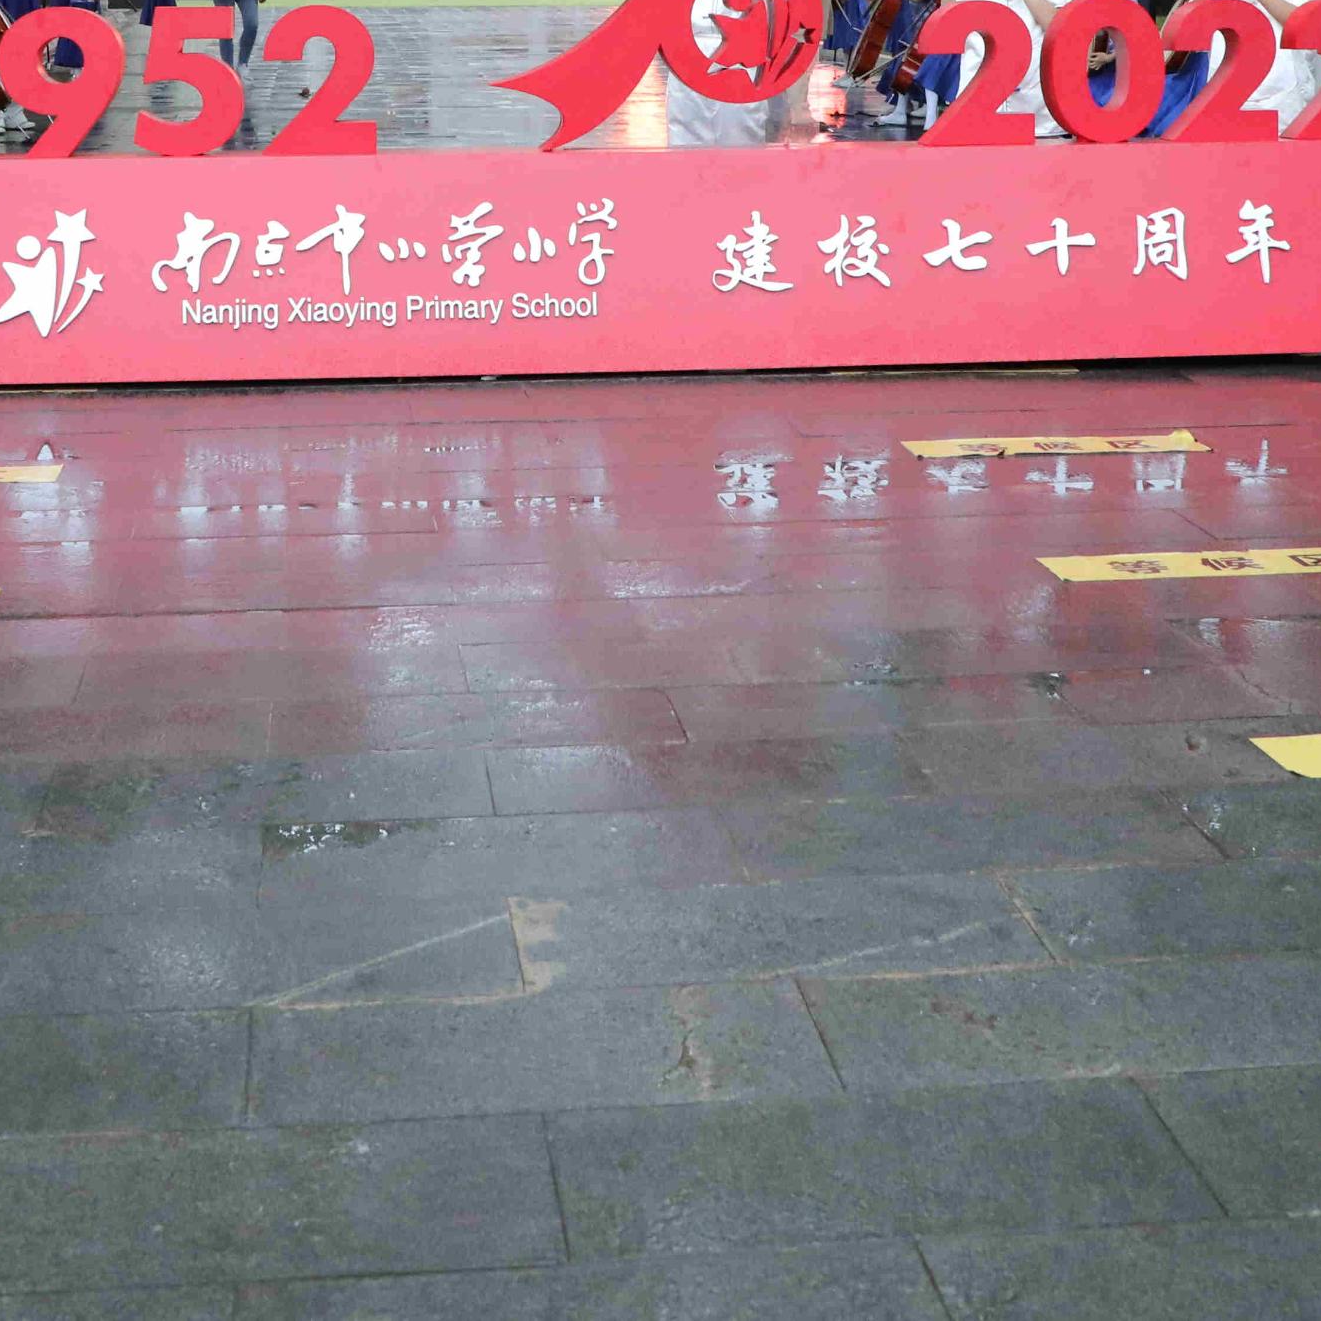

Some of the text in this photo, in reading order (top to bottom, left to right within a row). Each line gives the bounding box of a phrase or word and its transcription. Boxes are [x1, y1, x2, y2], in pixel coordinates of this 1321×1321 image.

[712, 198, 1291, 293] 建校七十周年
[181, 291, 598, 330] Nanjing Xiaoying Primary School
